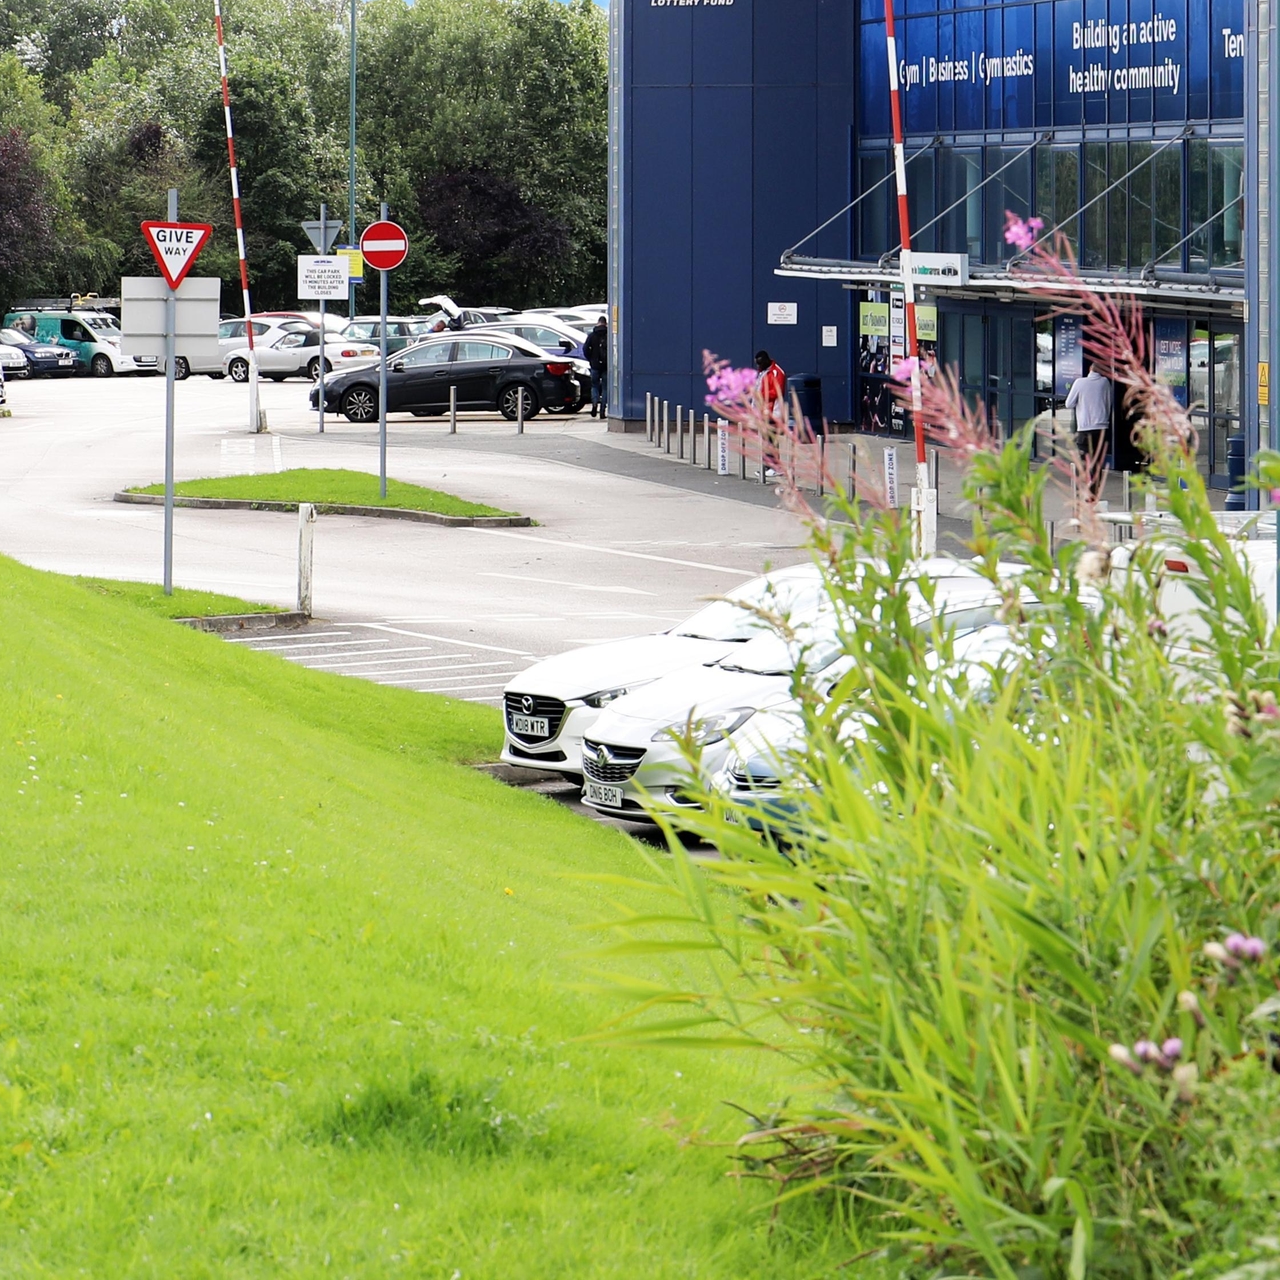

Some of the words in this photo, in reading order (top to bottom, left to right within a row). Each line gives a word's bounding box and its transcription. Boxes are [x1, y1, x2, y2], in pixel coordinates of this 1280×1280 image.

[1073, 19, 1119, 54] Building
[1123, 23, 1137, 45] an
[1140, 13, 1176, 44] active
[929, 55, 968, 82] Business
[979, 49, 1033, 85] Gymnastics
[1069, 63, 1111, 98] healthy
[1114, 58, 1180, 95] community
[157, 230, 193, 243] GIVE
[165, 247, 187, 255] WAY
